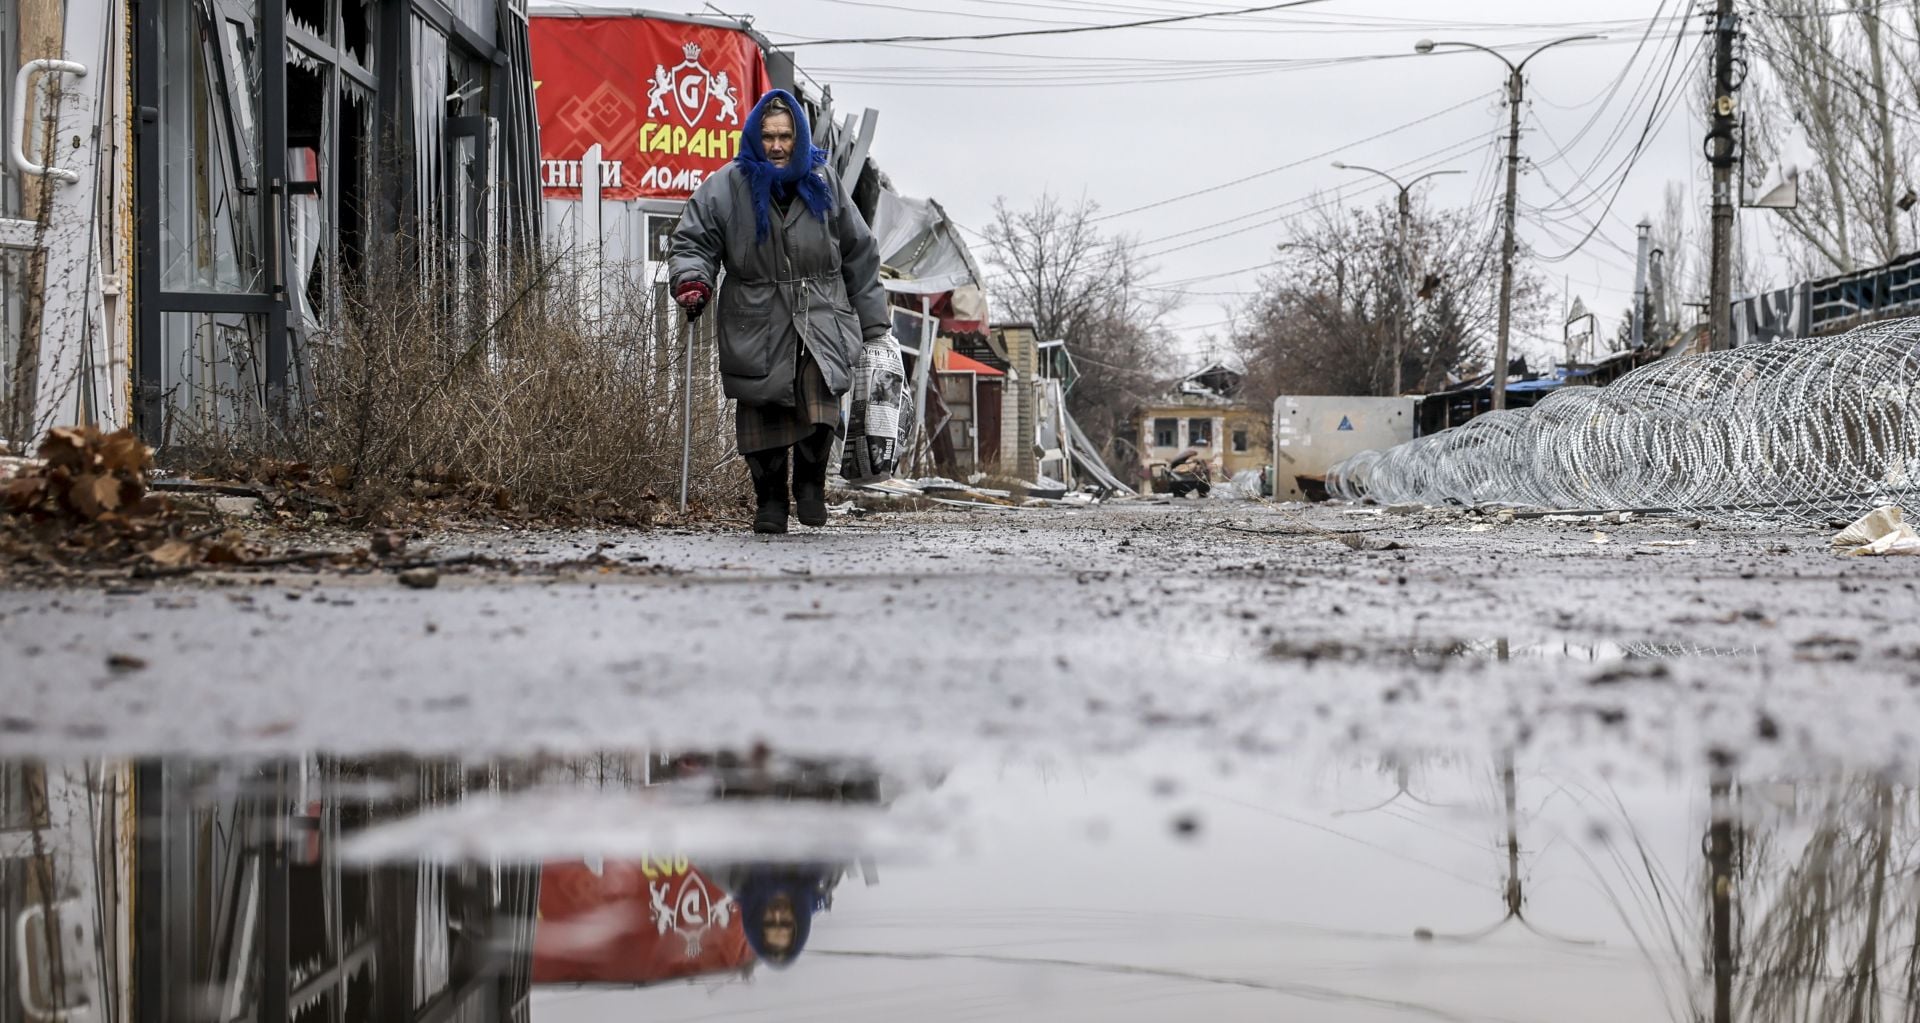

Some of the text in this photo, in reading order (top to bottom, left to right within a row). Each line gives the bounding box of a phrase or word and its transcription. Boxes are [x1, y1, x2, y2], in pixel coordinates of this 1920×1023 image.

[680, 75, 702, 108] G
[640, 123, 742, 159] ГАРАНТ
[541, 160, 622, 187] НІИ
[641, 166, 716, 190] ЛОМБ
